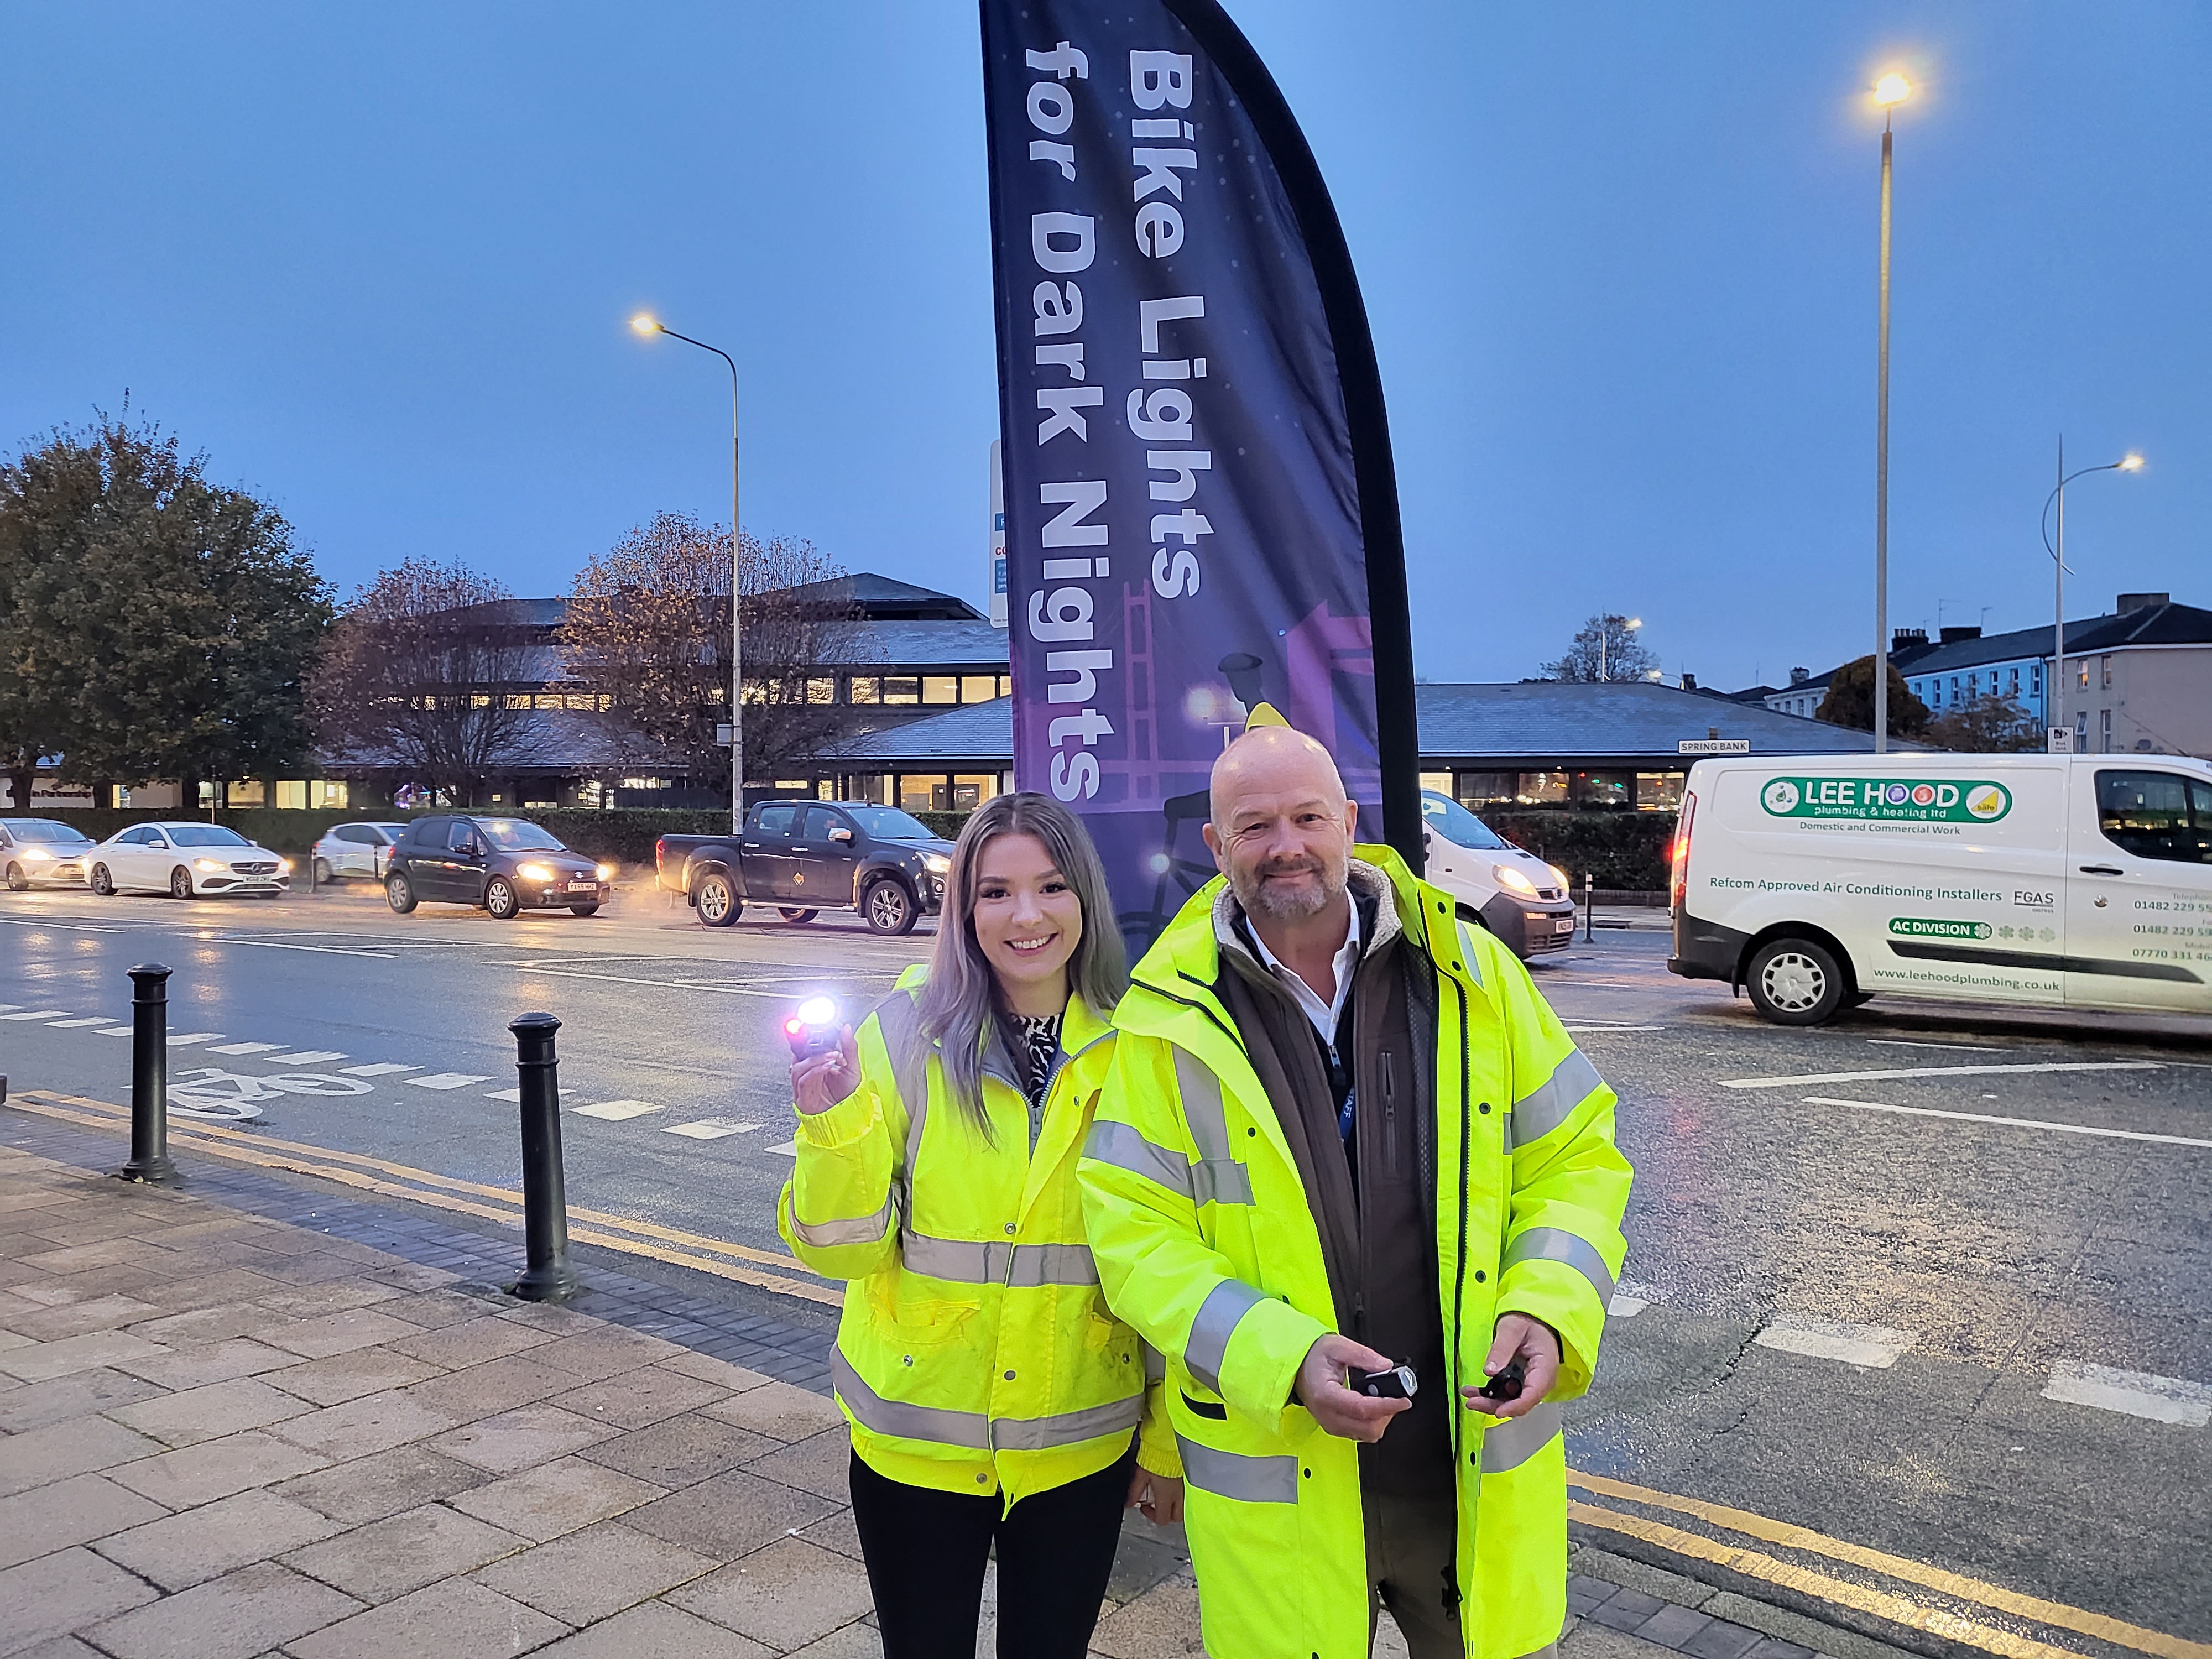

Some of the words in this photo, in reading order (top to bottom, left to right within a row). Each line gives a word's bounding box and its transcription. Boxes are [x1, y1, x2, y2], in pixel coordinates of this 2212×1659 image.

[1026, 41, 1089, 182] for
[1130, 50, 1198, 258] Bike
[1031, 212, 1104, 446] Dark
[1126, 295, 1215, 599] Lights
[1029, 480, 1115, 802] Nights
[1805, 781, 1856, 805] LEE
[1864, 782, 1959, 807] HOOD
[1814, 806, 1866, 817] plumbing
[1870, 807, 1878, 816] &
[1882, 807, 1927, 819] heating
[1931, 810, 1947, 818] ltd
[1800, 822, 1845, 830] Domestic
[1869, 823, 1929, 834] Commercial
[1933, 826, 1960, 834] Work
[1710, 877, 1754, 888] Refcom
[1757, 879, 1819, 891] Approved
[1823, 882, 1842, 893] Air
[1846, 883, 1933, 900] Conditioning
[1937, 888, 2002, 901] Installers
[2014, 891, 2054, 904] FGAS
[2135, 900, 2169, 910] 01482
[2173, 902, 2194, 911] 229
[1893, 921, 1910, 932] AC
[1913, 922, 1970, 935] DIVISION
[2133, 924, 2168, 933] 01482
[2173, 926, 2194, 936] 229
[2132, 948, 2168, 958] 07770
[1874, 969, 2060, 991] www.leehoodplumbing.co.uk
